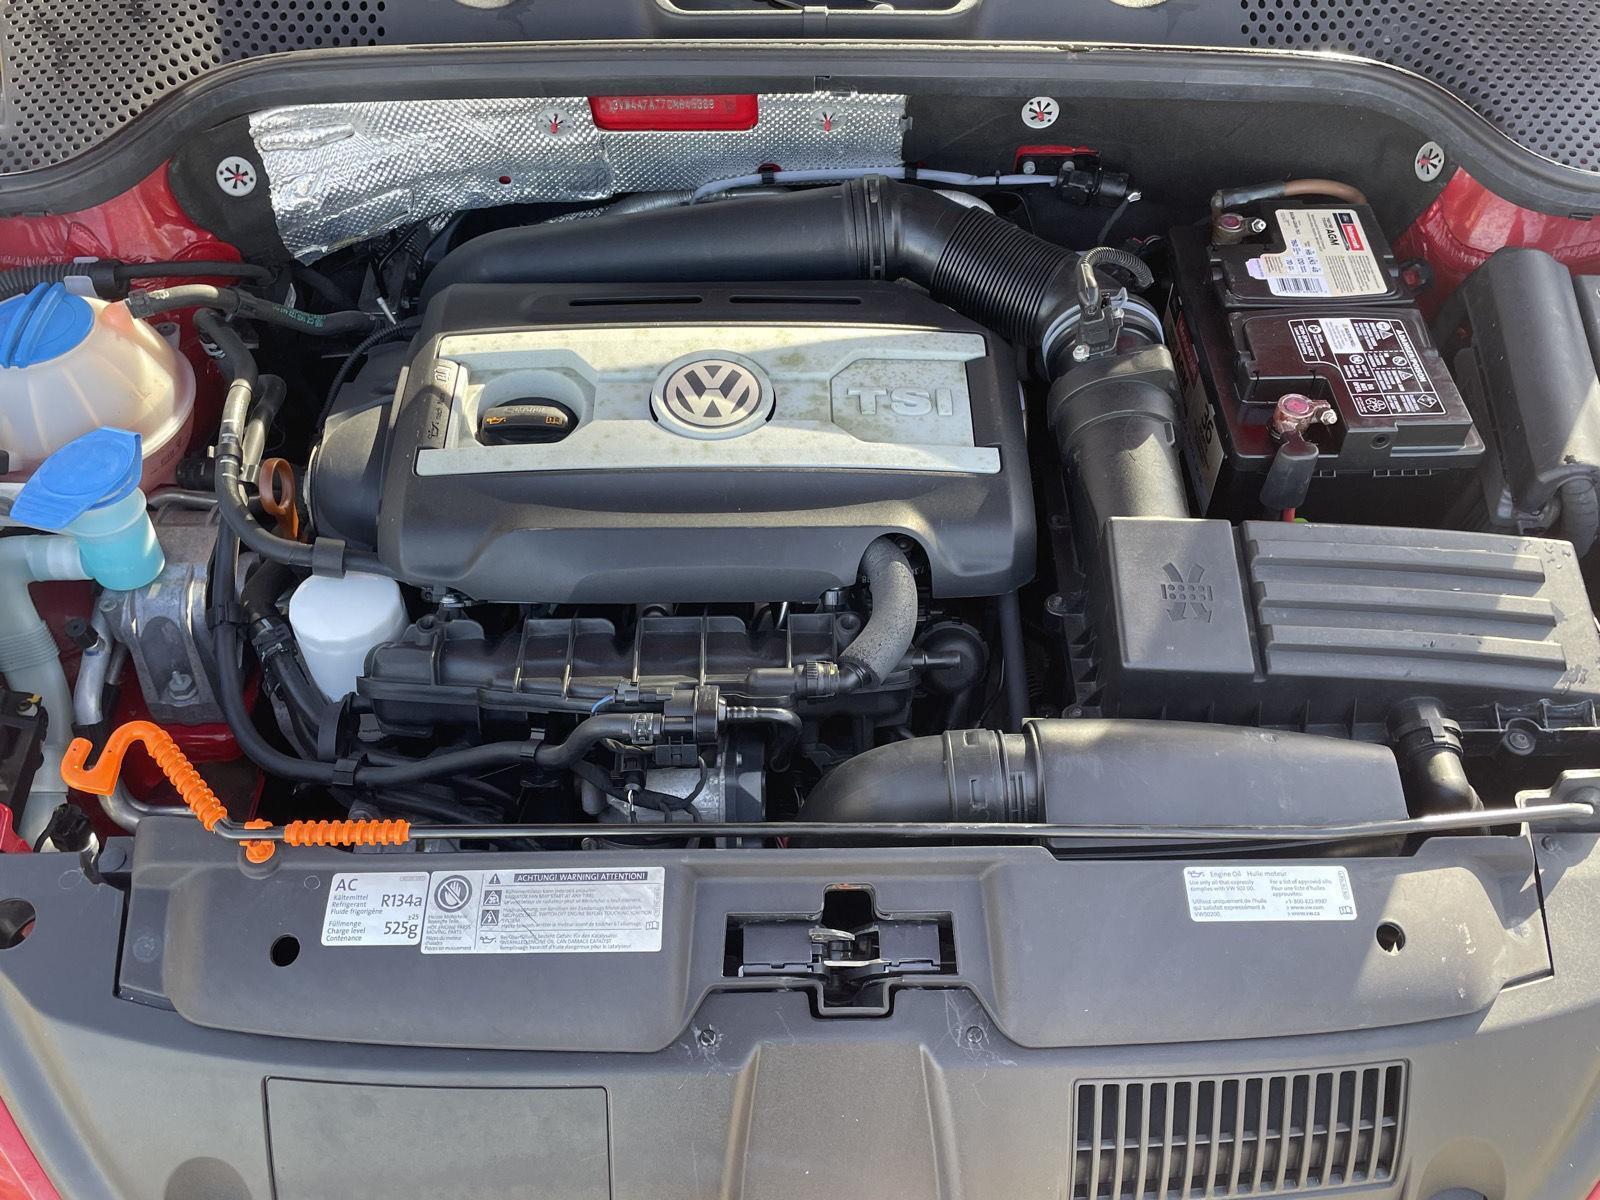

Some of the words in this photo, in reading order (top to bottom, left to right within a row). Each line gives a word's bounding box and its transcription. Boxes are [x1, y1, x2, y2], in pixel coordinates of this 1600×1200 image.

[1325, 229, 1339, 245] AGM
[846, 385, 953, 416] TSI
[559, 873, 599, 881] WARNING!
[600, 872, 645, 880] ATTENTION!
[335, 878, 358, 891] AC
[332, 902, 367, 910] Refrigerant
[381, 893, 422, 907] R134a
[328, 920, 361, 928] Füllmenge
[384, 921, 418, 939] 525g
